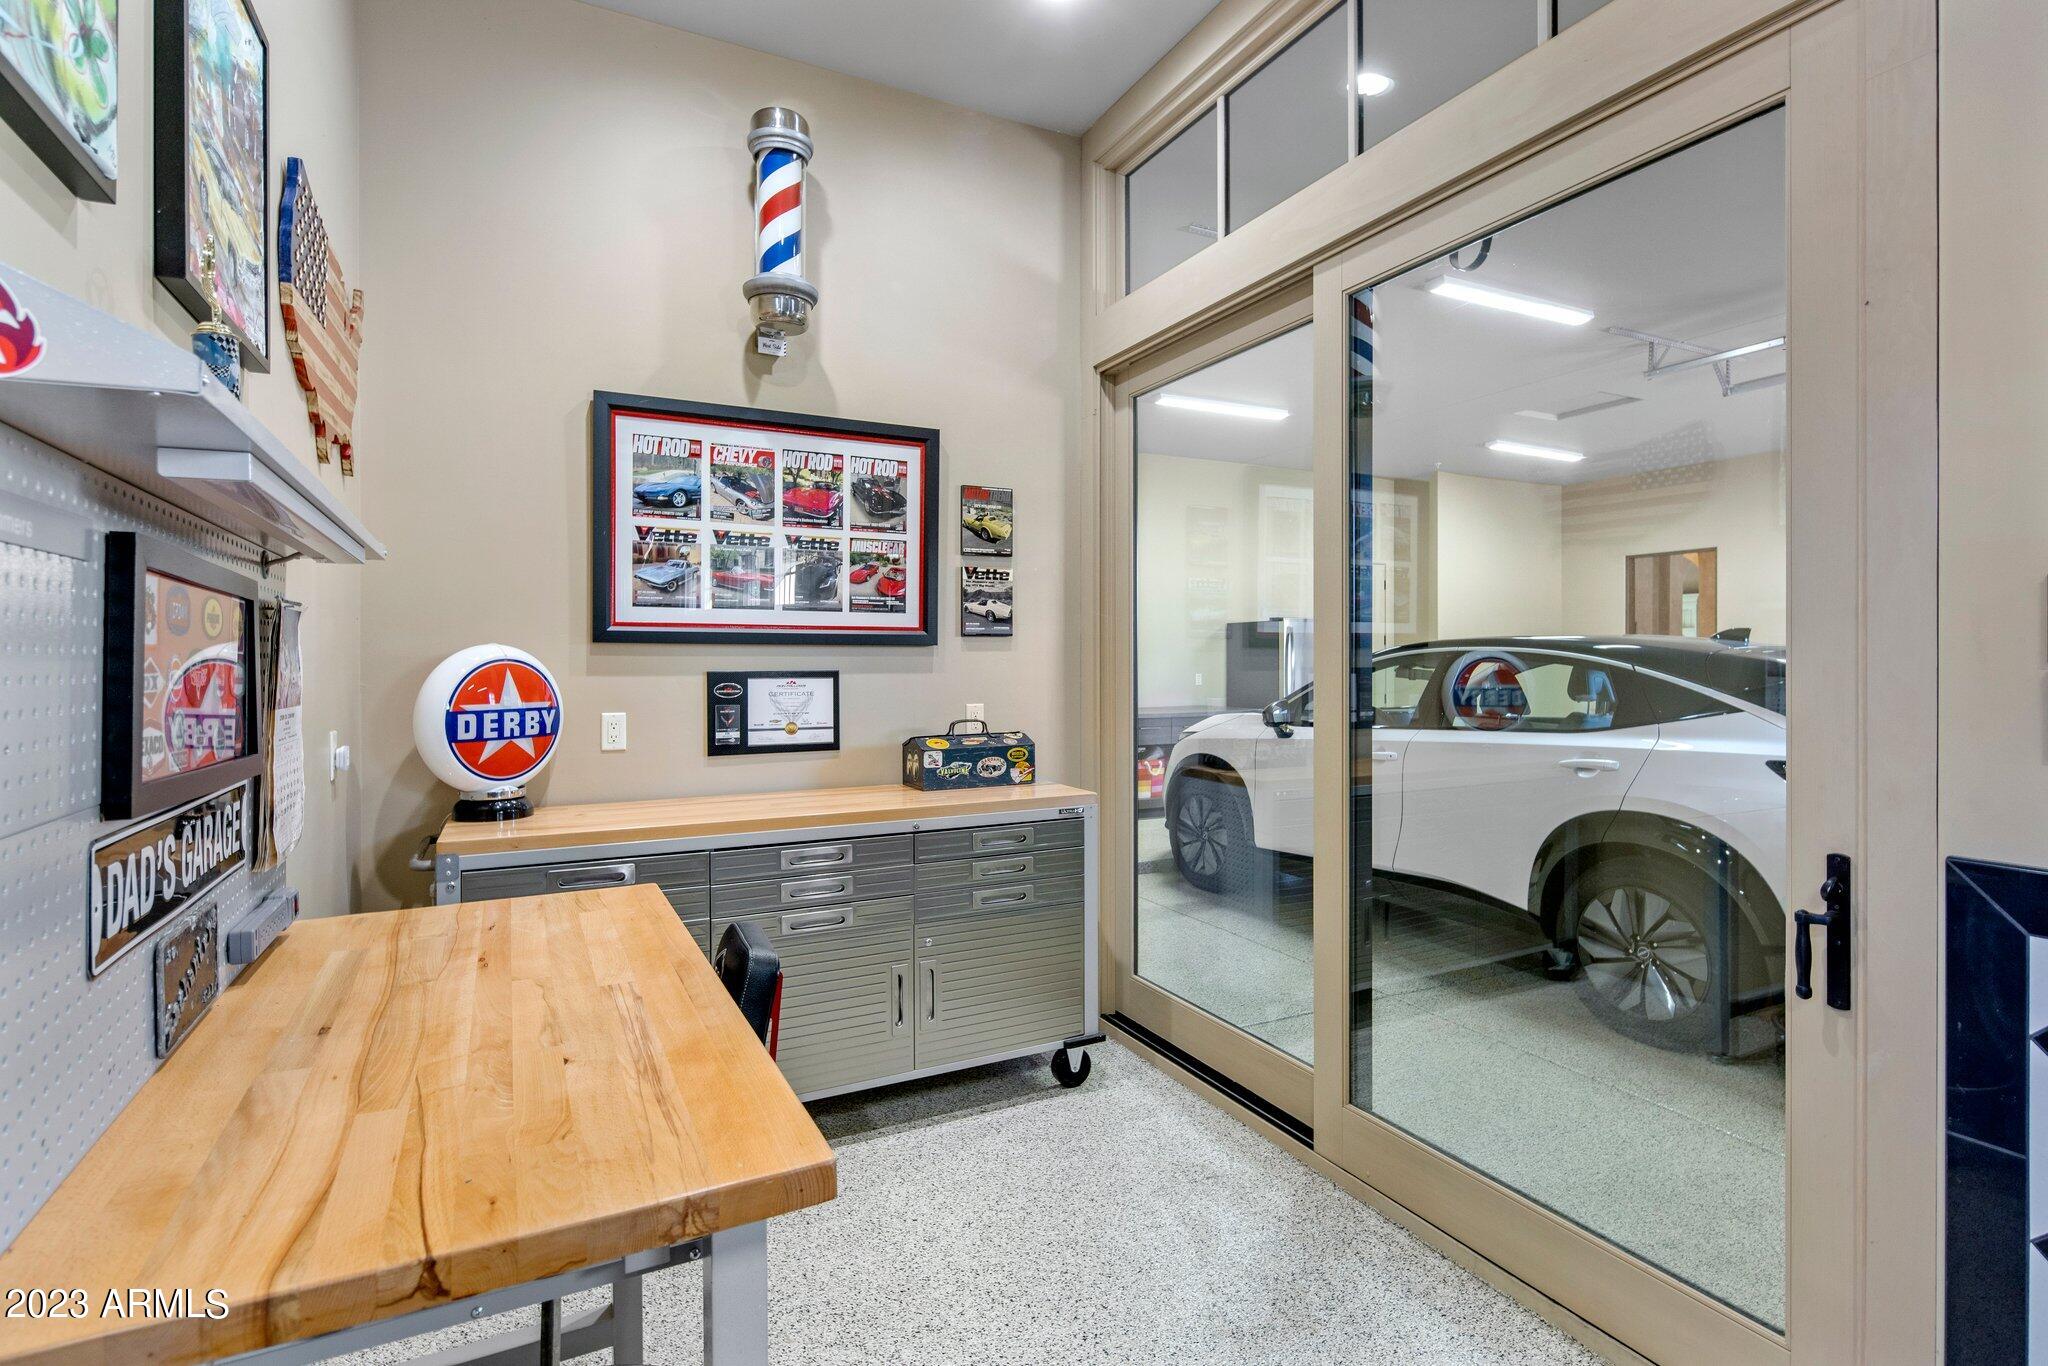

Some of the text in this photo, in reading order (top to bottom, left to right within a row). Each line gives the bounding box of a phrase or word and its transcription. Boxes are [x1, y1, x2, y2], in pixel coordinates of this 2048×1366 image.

[632, 434, 662, 456] HOT
[661, 436, 690, 458] ROD
[713, 446, 757, 463] CHEVY
[783, 450, 808, 470] HOT
[808, 452, 833, 471] ROD
[851, 457, 875, 476] HOT
[873, 459, 898, 477] ROD
[635, 525, 698, 543] Vette
[712, 529, 771, 547] Vette
[784, 534, 840, 551] Vette
[964, 566, 1010, 581] Vette
[768, 690, 815, 698] CERTIFICATE
[456, 708, 557, 741] DERBY
[107, 800, 241, 940] DAD'S GARAGE
